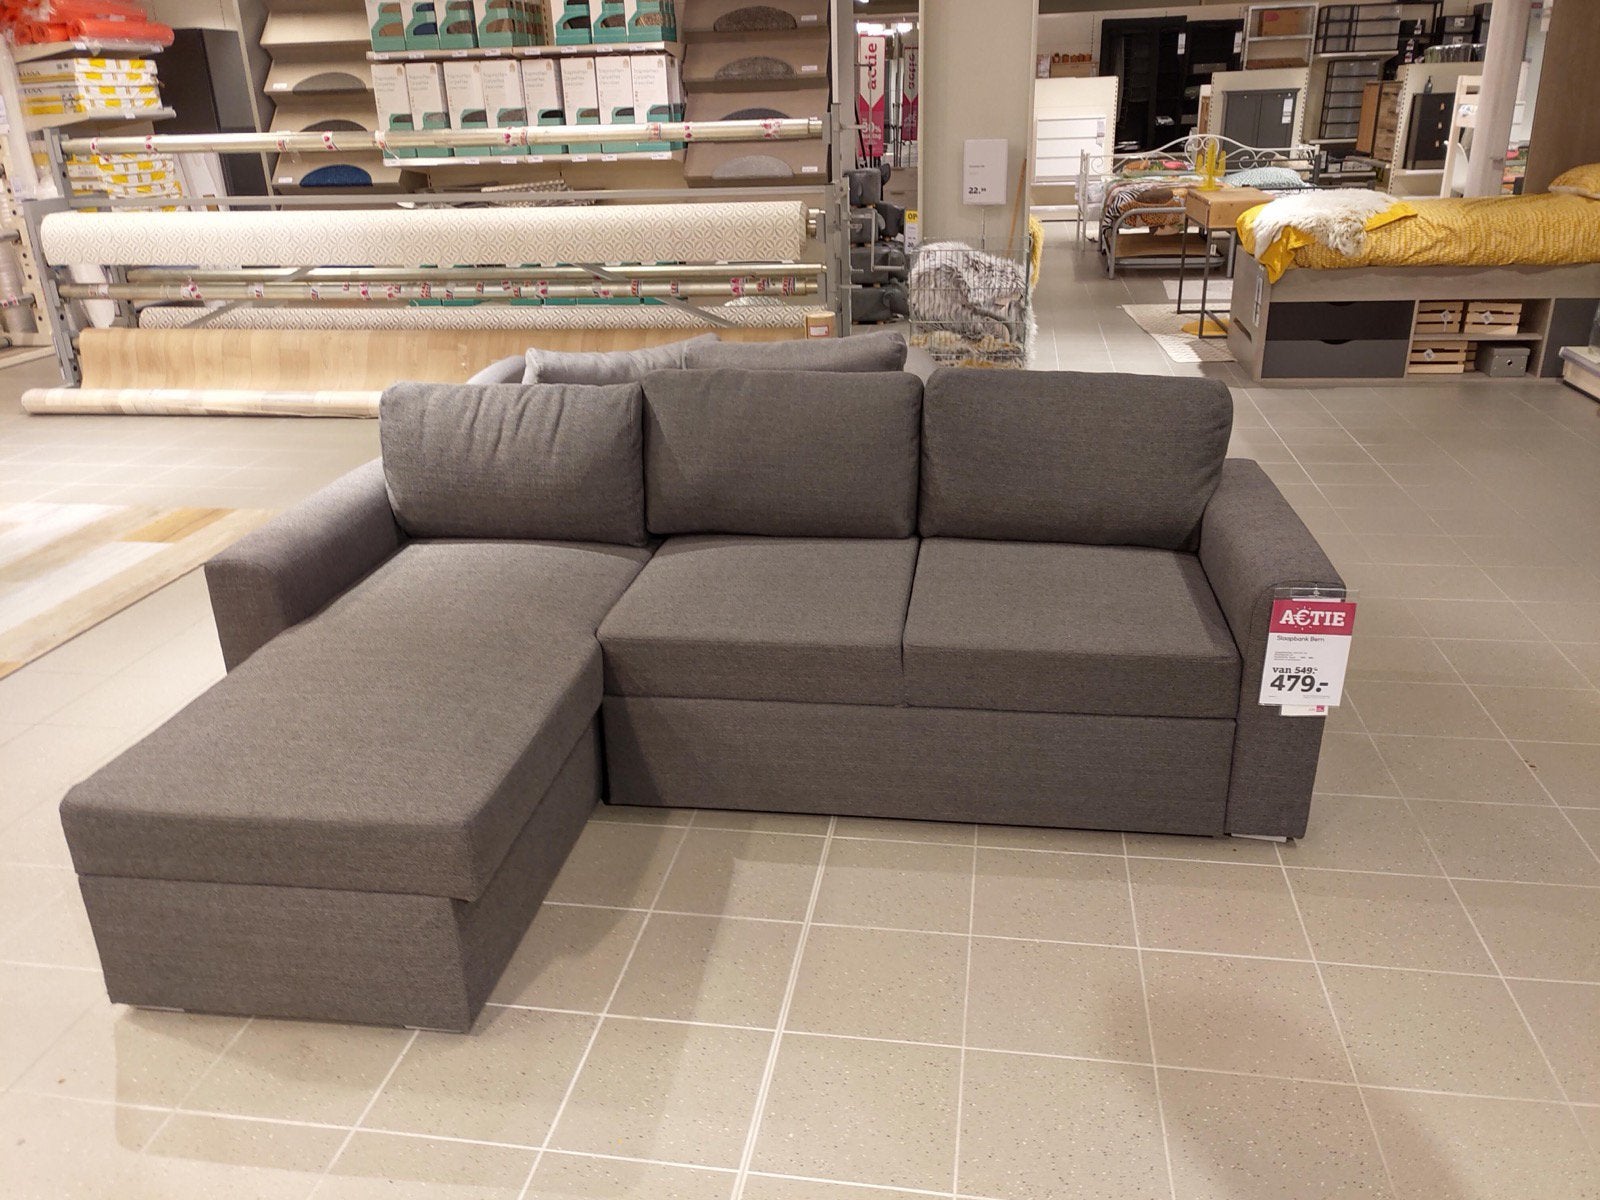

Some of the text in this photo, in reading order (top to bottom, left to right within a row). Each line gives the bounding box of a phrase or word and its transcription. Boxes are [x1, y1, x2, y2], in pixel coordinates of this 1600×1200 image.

[865, 42, 878, 90] actie
[1272, 666, 1292, 674] van
[1270, 674, 1329, 693] 479.-
